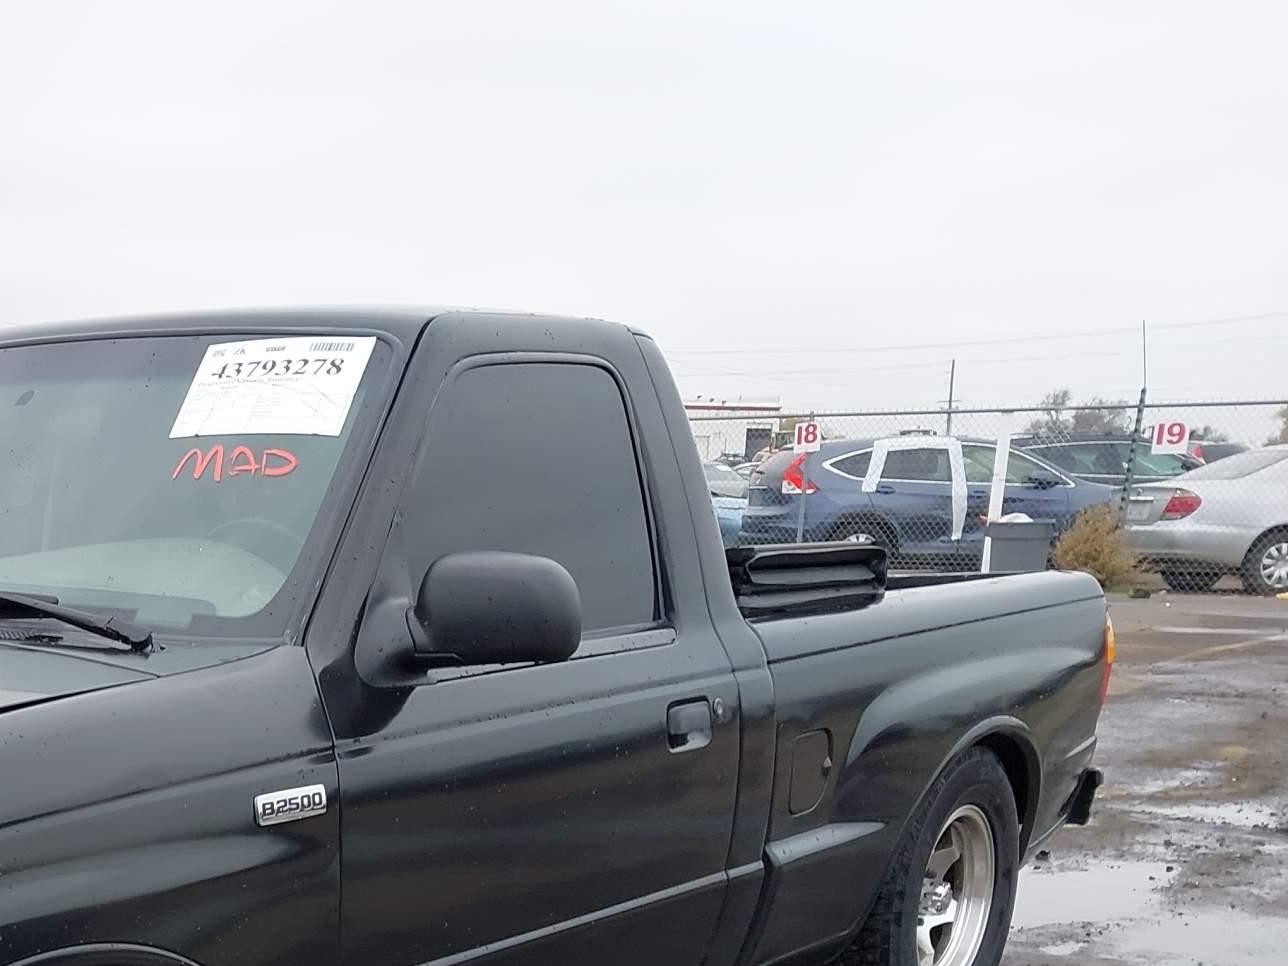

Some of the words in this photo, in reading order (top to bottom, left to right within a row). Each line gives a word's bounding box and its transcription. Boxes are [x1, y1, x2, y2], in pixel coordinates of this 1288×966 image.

[212, 358, 344, 379] 43793278
[797, 423, 818, 445] 18
[1156, 422, 1186, 445] 19
[172, 445, 297, 483] MAD
[261, 792, 323, 817] B2500
